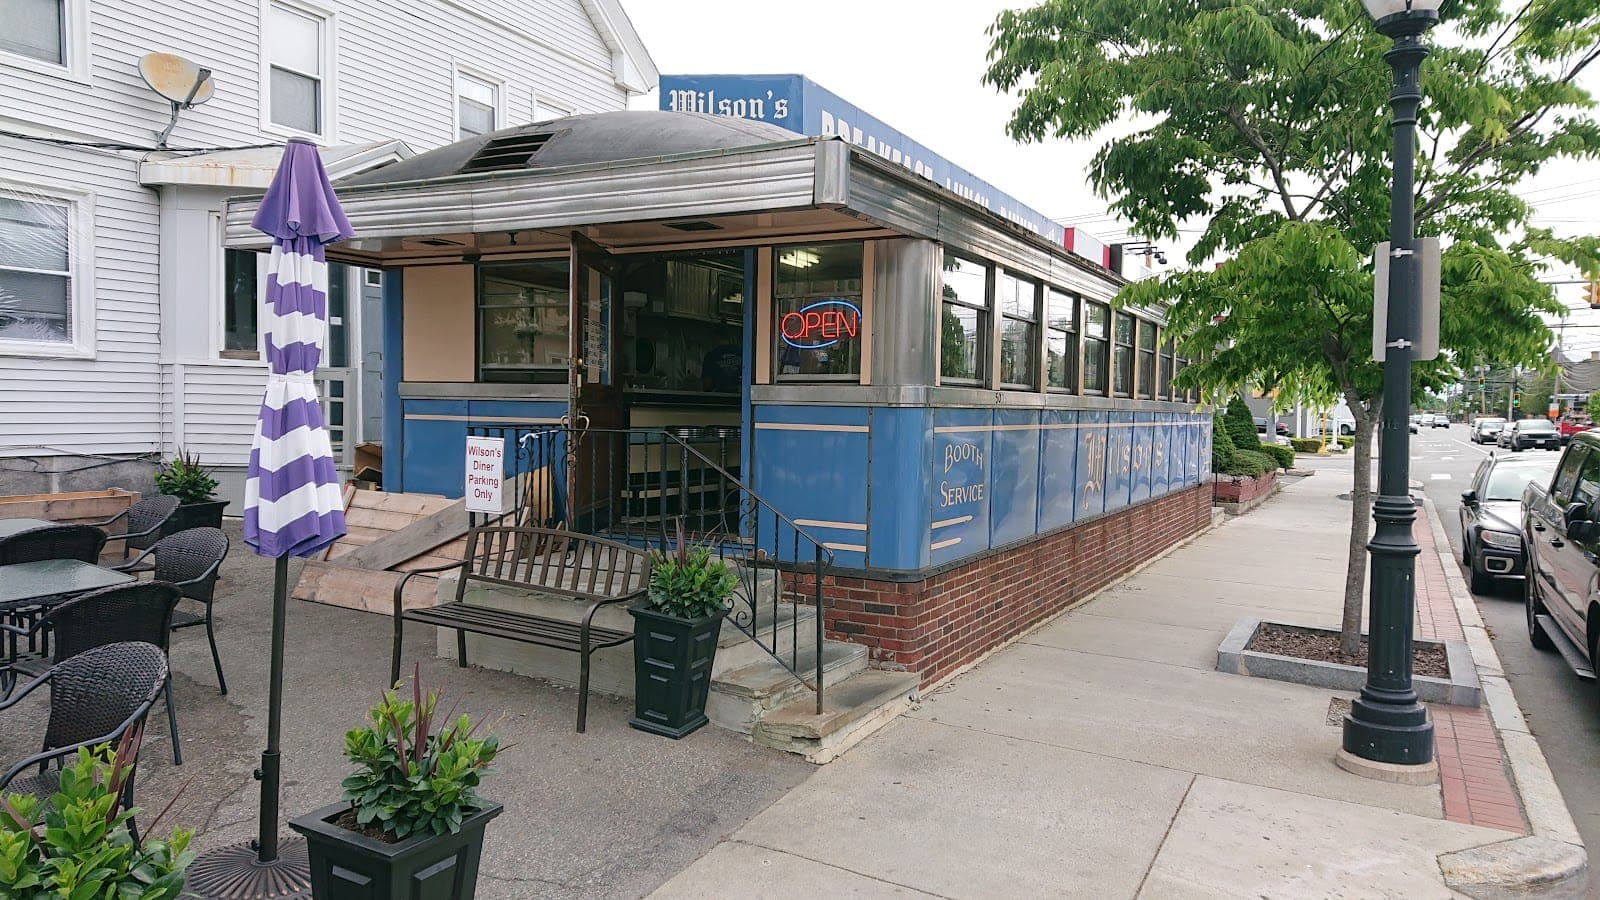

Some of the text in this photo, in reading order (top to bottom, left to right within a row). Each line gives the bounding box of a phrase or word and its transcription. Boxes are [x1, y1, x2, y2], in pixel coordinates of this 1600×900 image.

[668, 89, 788, 119] Wilson's
[781, 310, 857, 339] OPEN
[467, 446, 502, 458] Wilson's
[944, 443, 983, 473] BOOTH
[473, 460, 495, 471] Diner
[468, 475, 499, 488] Parking
[474, 488, 493, 502] Only
[940, 480, 984, 507] SERVICE
